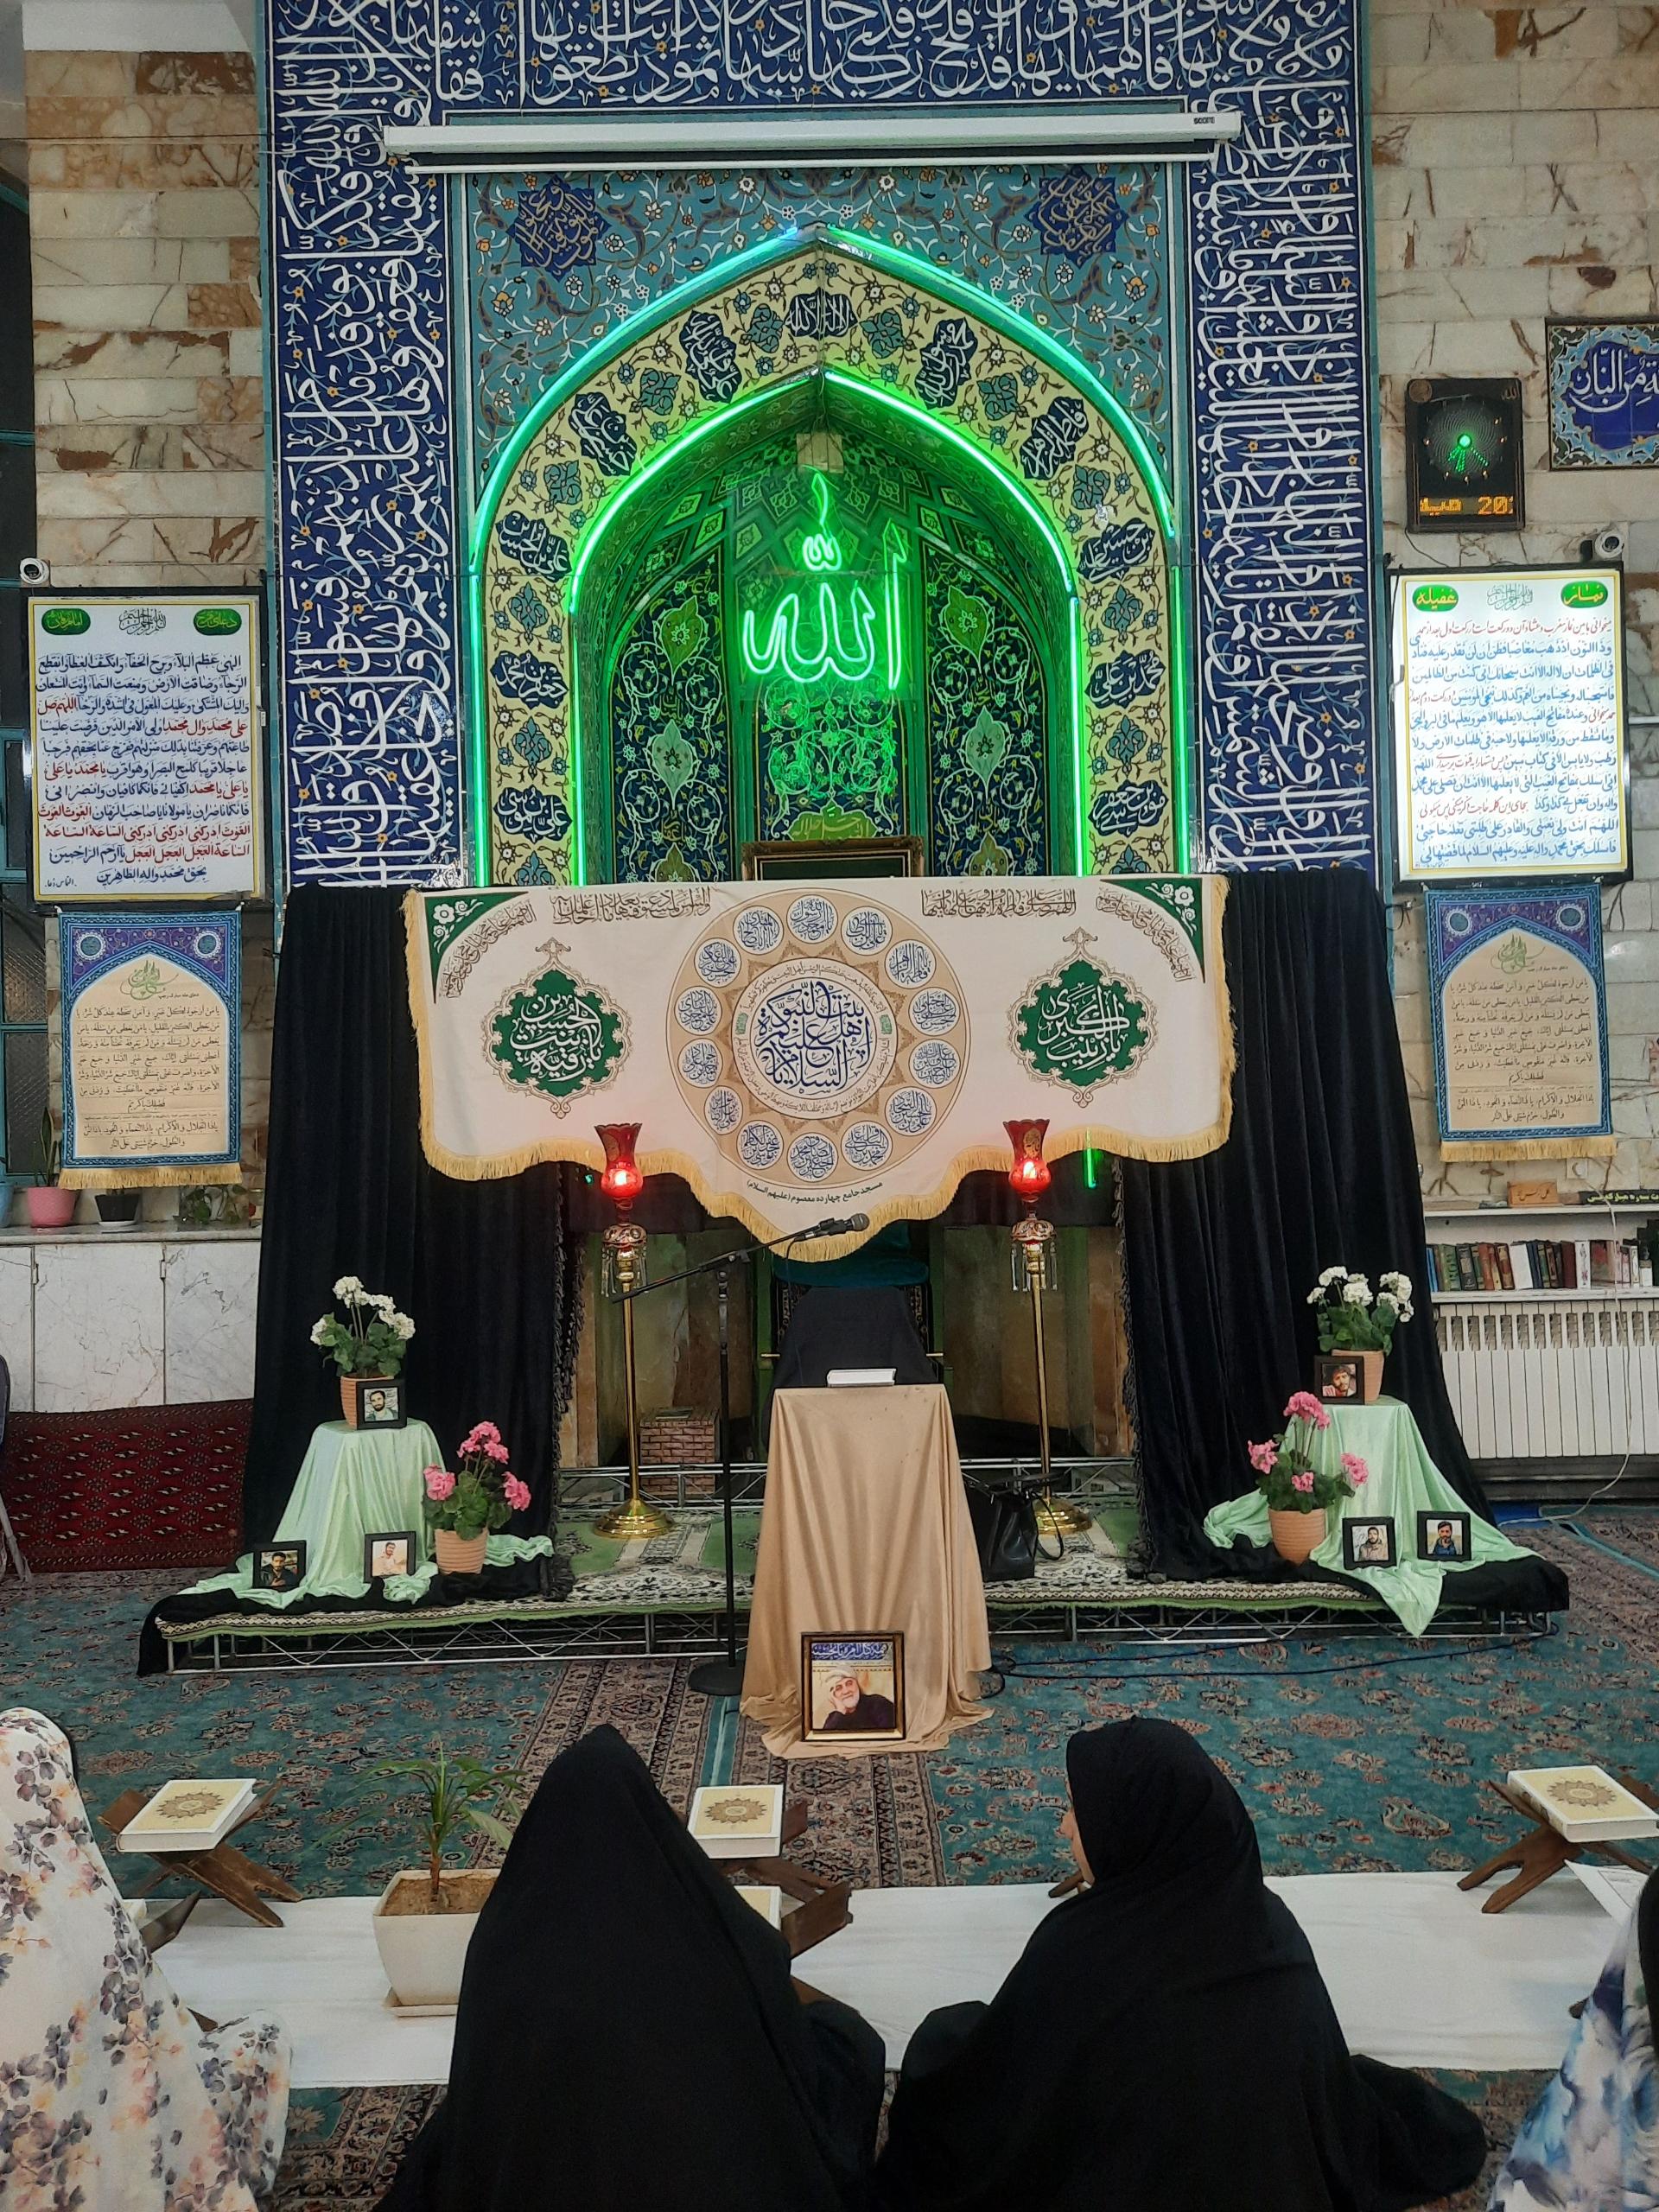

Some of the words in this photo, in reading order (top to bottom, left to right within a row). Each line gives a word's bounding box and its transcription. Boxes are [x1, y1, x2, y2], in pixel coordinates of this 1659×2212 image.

[741, 472, 907, 693] الله
[1416, 588, 1456, 609] غفیله
[1564, 583, 1603, 604] نماز
[861, 1180, 884, 1194] مسجد
[791, 1196, 817, 1205] معصوم
